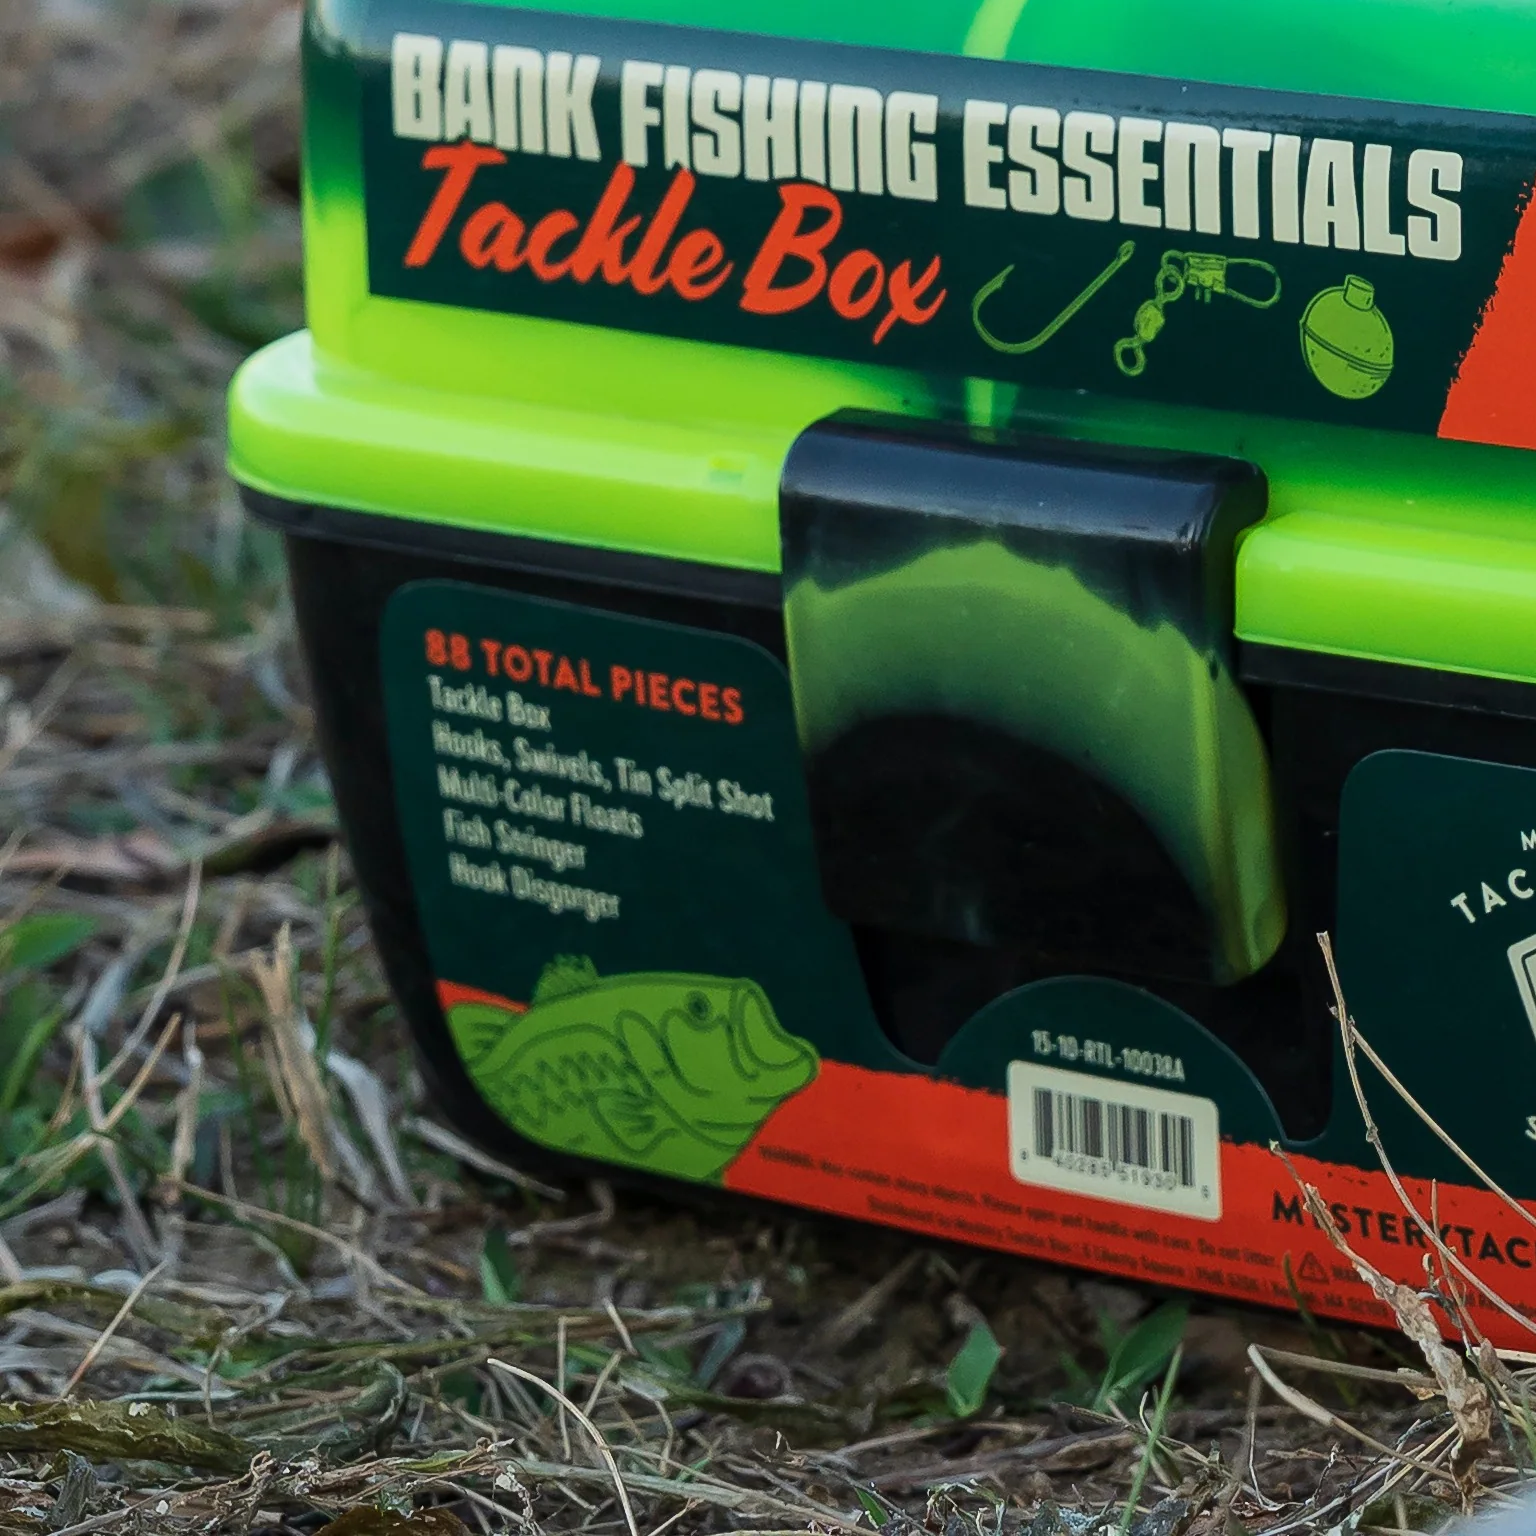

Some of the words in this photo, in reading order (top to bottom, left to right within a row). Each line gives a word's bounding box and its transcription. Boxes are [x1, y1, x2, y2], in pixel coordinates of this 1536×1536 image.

[392, 31, 601, 162] BANK
[621, 61, 939, 203] FISHING
[963, 99, 1463, 262] ESSENTIALS
[404, 139, 733, 301] Tackle
[740, 183, 947, 344] Box
[425, 628, 472, 671] 88
[480, 638, 601, 698] TOTAL
[609, 664, 744, 725] PIECES
[426, 674, 503, 722] Tackle
[505, 690, 551, 732] Box
[570, 792, 644, 839] Floats
[656, 766, 714, 810] Split
[717, 778, 775, 822] Shot
[443, 808, 492, 849] Fish
[494, 819, 587, 872] Stringer
[449, 852, 509, 895] Hook
